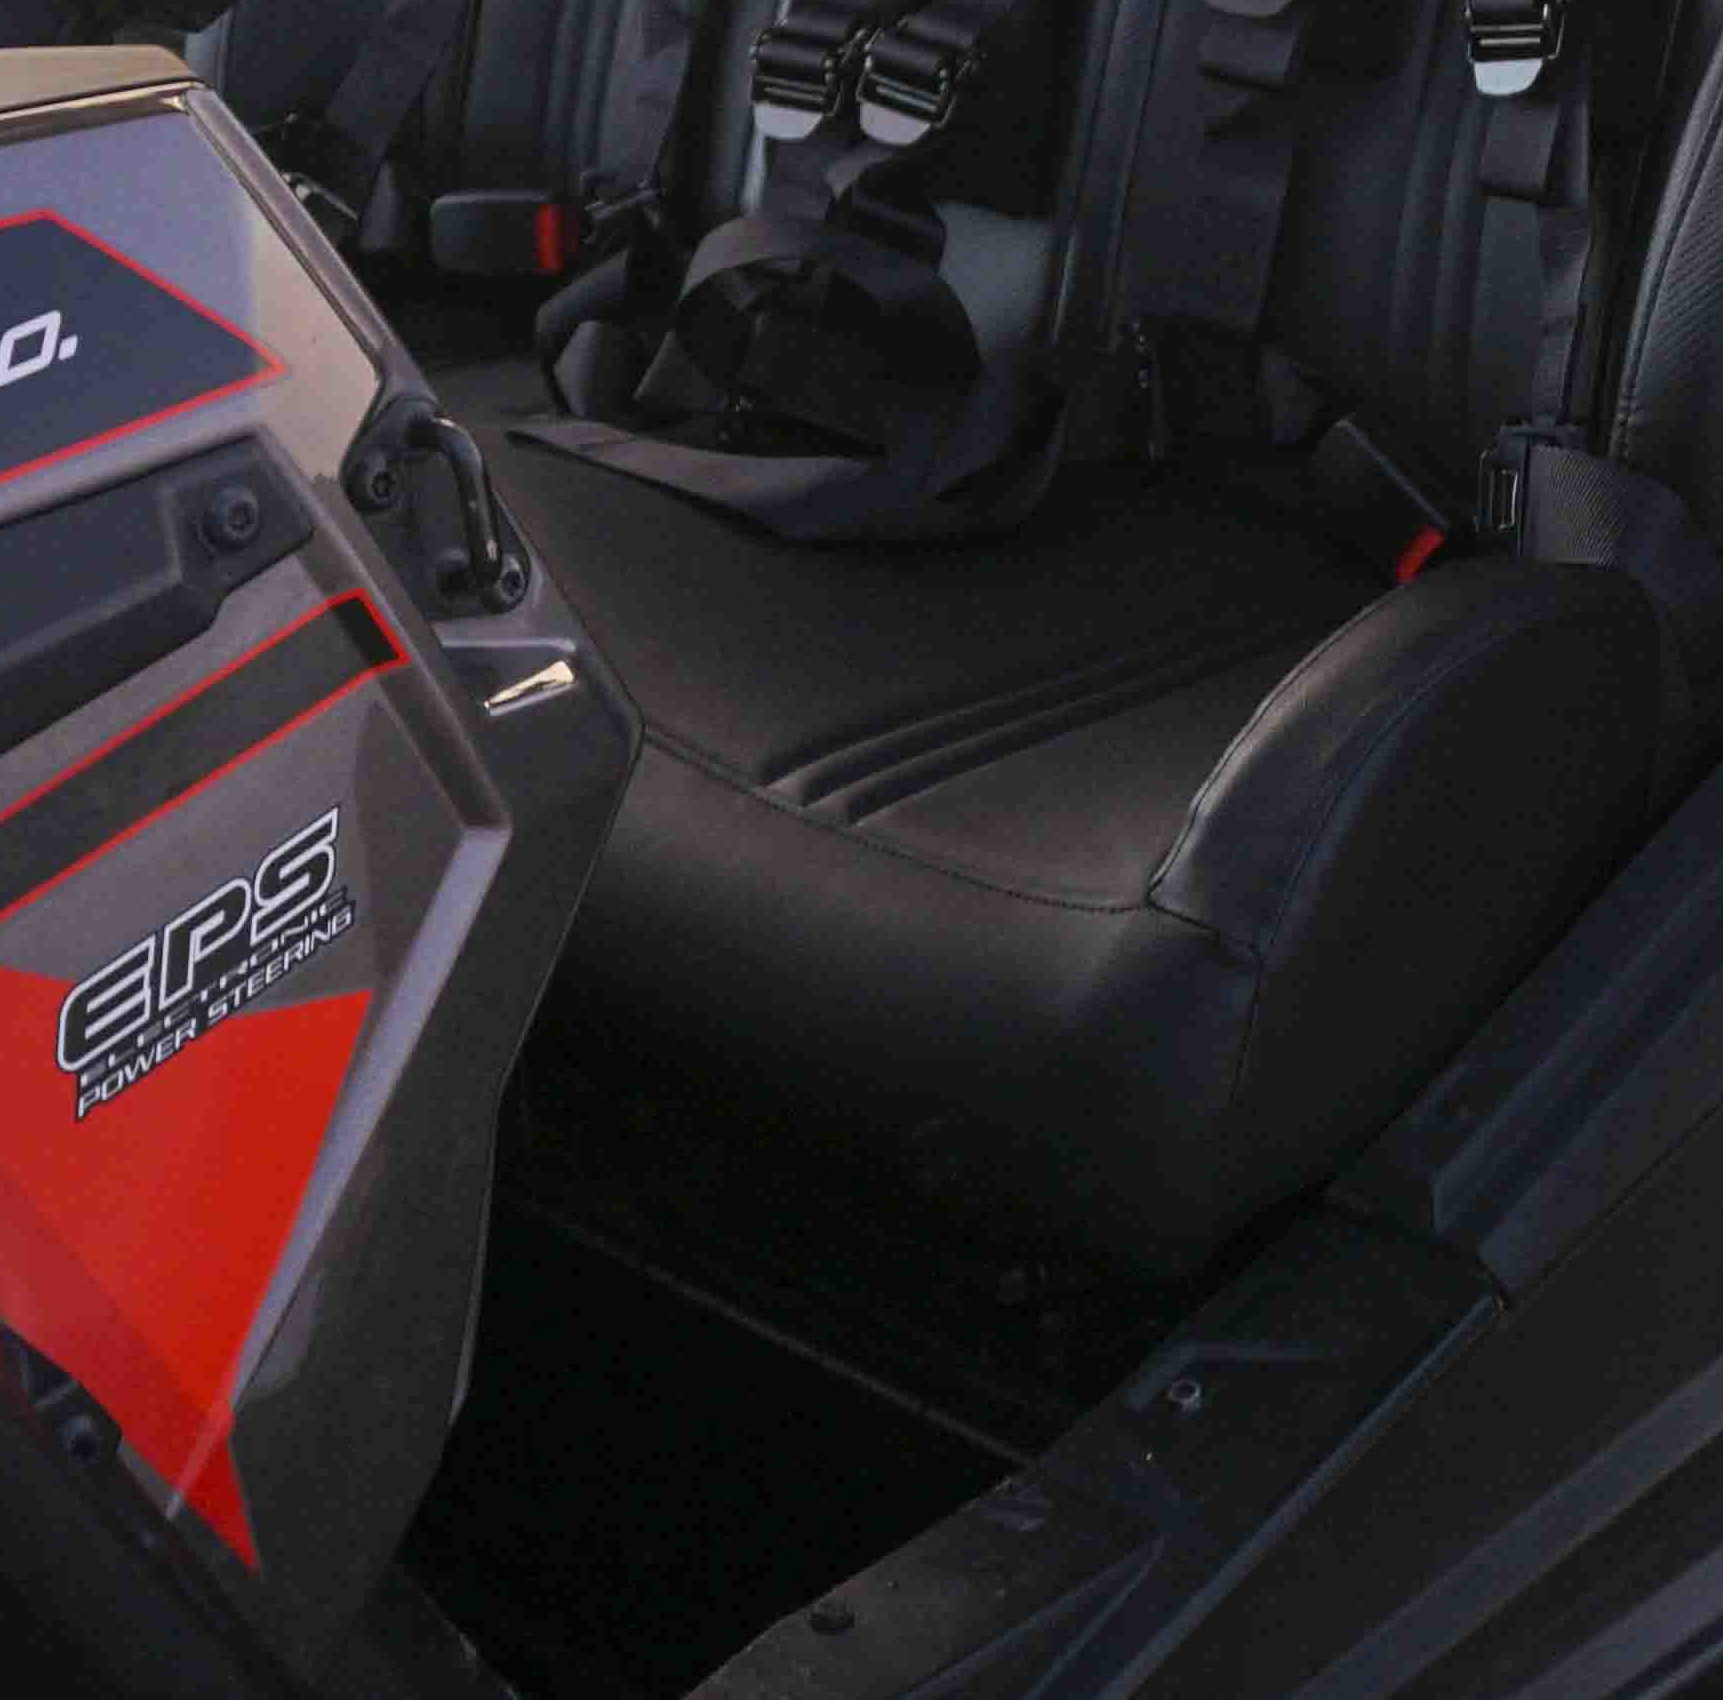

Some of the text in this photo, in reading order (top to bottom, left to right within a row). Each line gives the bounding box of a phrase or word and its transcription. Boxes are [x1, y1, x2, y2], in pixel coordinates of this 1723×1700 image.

[56, 806, 341, 1072] EPS
[77, 904, 353, 1118] POWER STEERING
